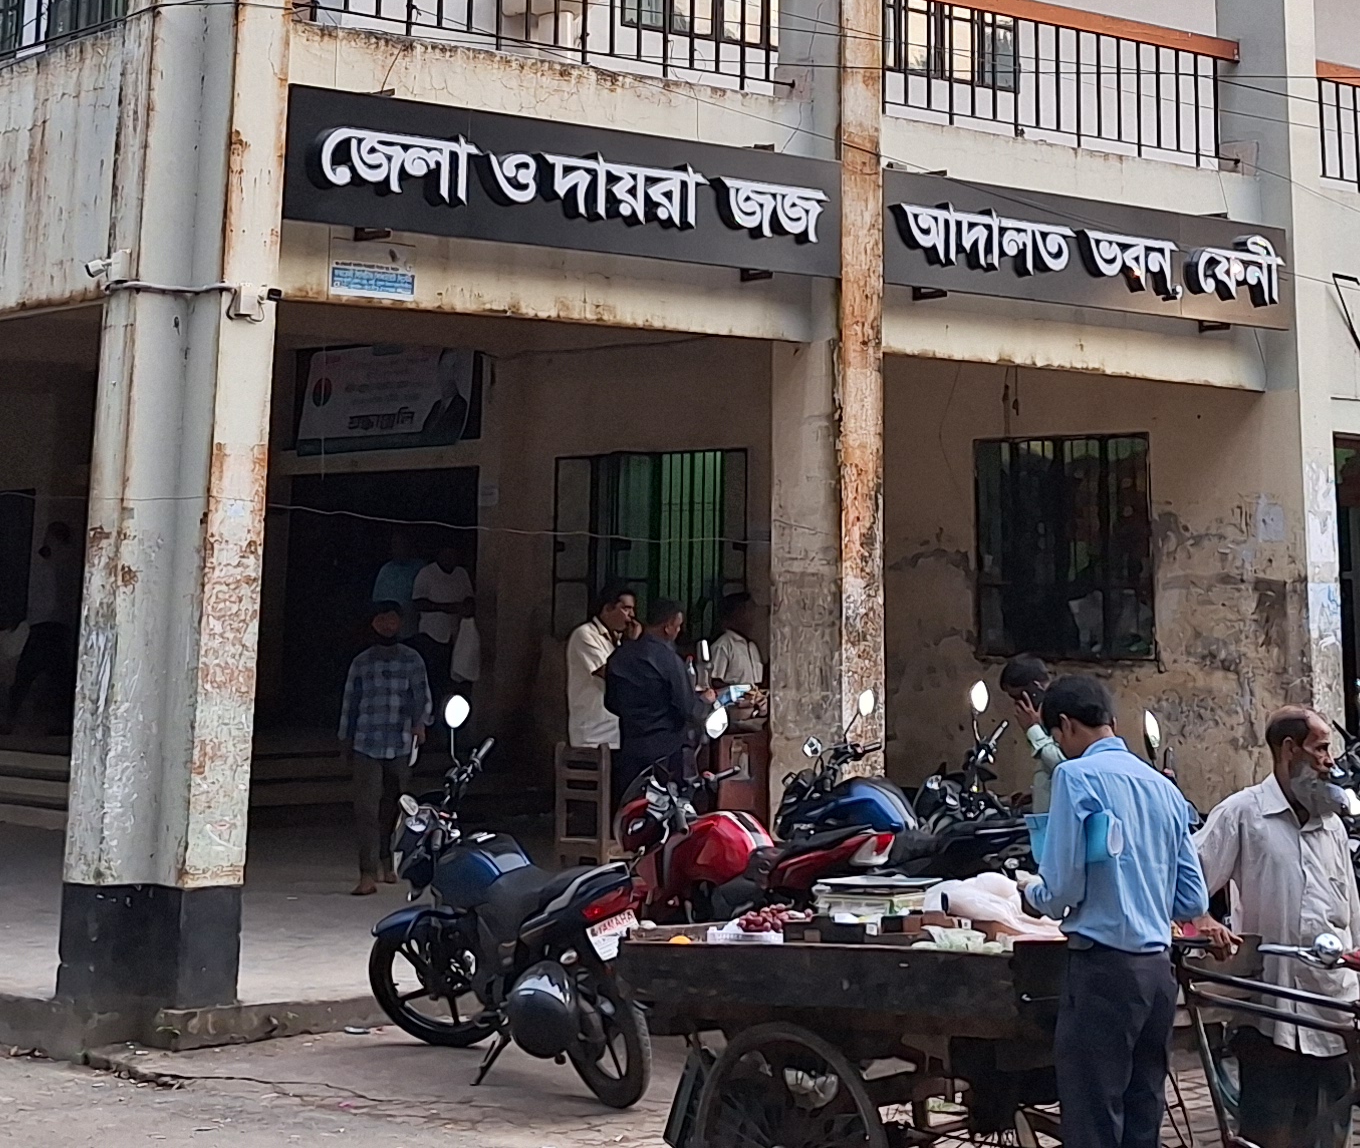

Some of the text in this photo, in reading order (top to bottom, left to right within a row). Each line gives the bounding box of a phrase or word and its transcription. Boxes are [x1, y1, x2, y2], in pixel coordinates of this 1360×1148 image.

[321, 127, 483, 205] জেলা
[489, 150, 538, 204] ও
[544, 151, 710, 229] দায়রা
[723, 176, 830, 244] জজ
[902, 202, 1076, 276] আদালত
[1199, 234, 1286, 306] ফেনী
